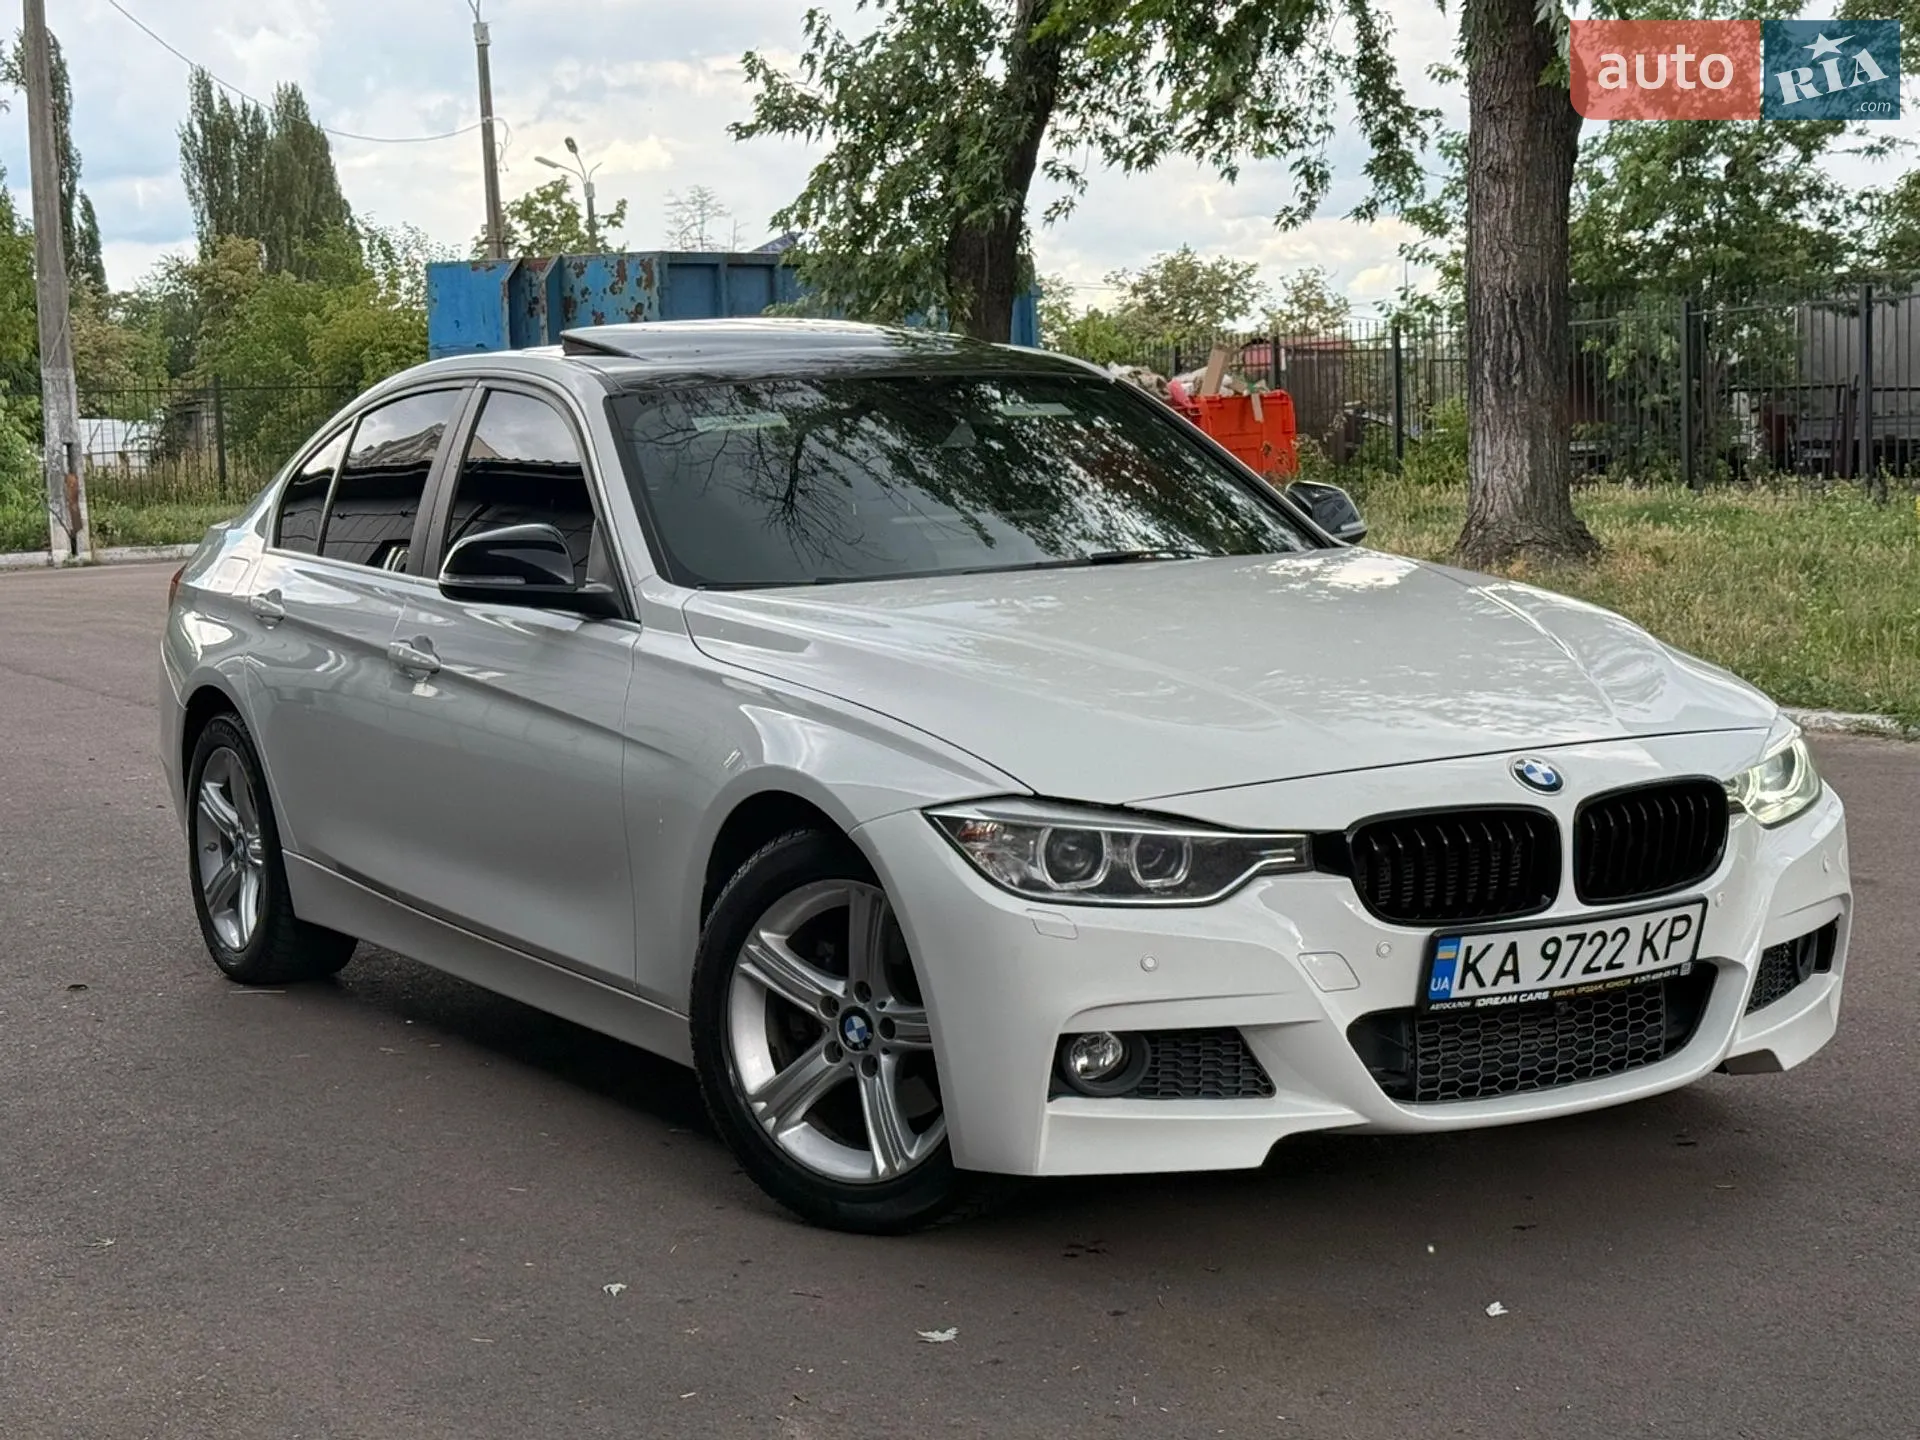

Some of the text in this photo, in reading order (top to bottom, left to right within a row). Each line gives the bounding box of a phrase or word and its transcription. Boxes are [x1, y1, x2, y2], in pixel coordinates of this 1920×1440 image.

[1458, 913, 1692, 991] KA 9722 KP
[1430, 975, 1450, 991] UA
[1519, 990, 1550, 1003] CARS
